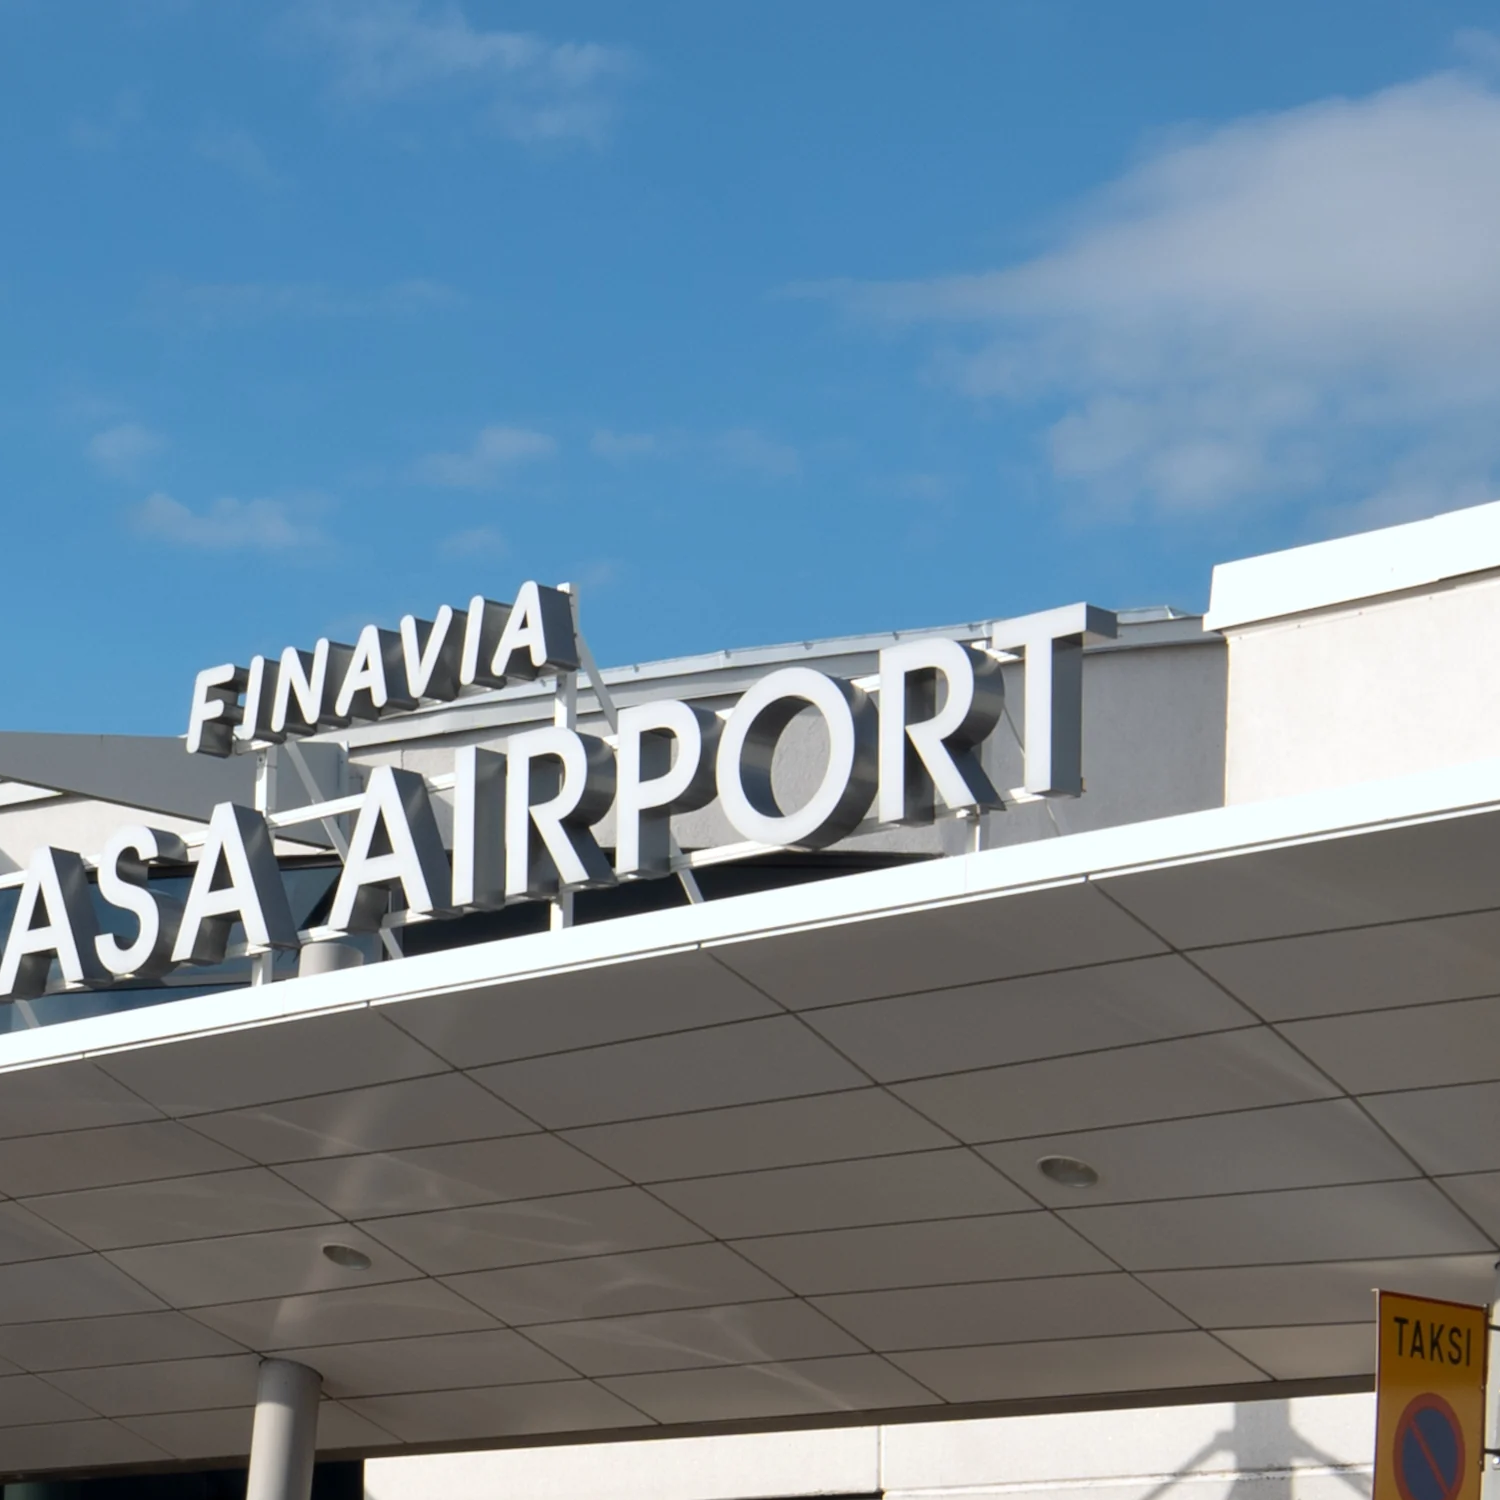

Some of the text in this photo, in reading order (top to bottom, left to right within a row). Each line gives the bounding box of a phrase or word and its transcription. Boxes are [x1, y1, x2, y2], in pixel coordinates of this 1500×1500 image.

[186, 580, 577, 756] FINAVIA
[328, 602, 1117, 934] AIRPORT
[1393, 1316, 1472, 1367] TAKSI
